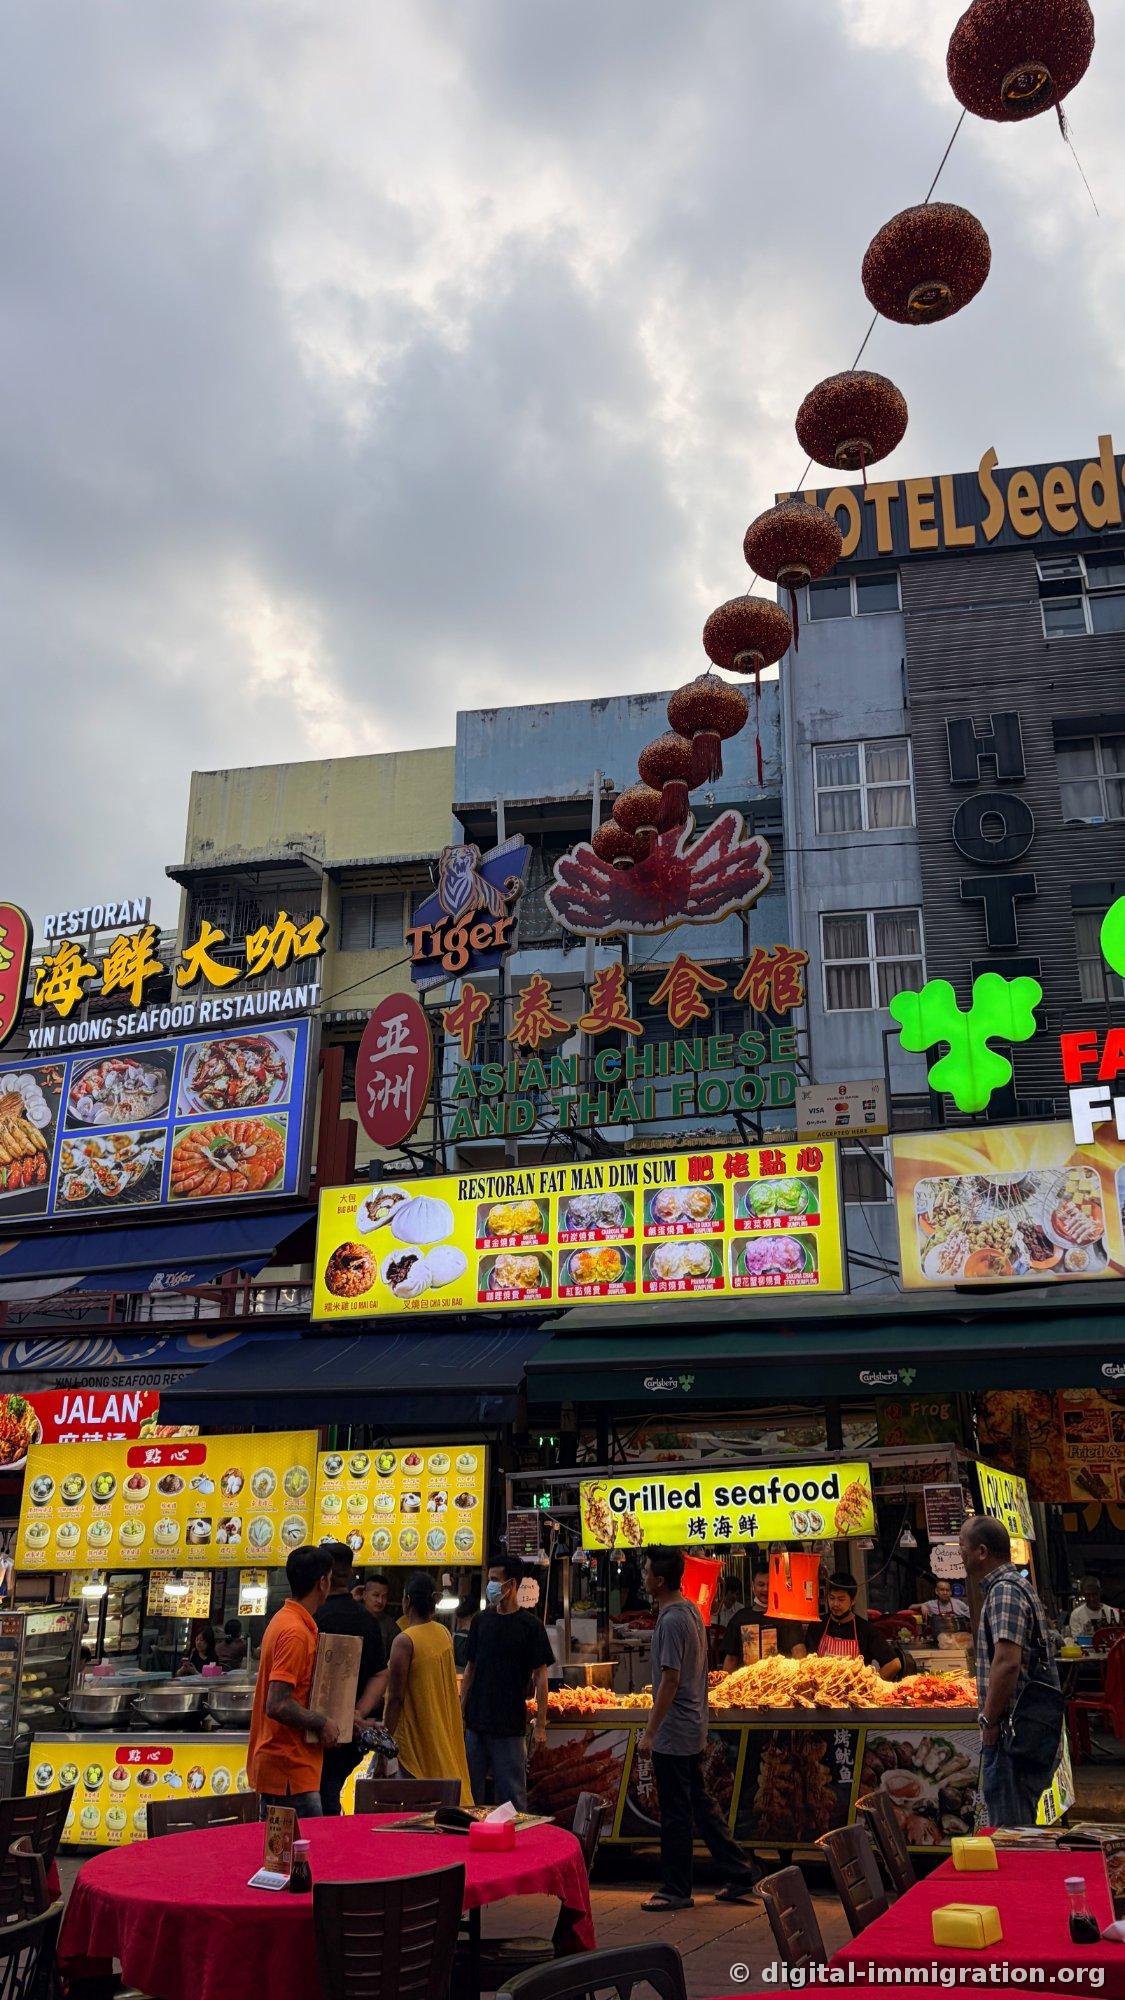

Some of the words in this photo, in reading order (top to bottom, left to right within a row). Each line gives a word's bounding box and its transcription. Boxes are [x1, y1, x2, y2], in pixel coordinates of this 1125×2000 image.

[779, 475, 976, 558] OTEL
[977, 434, 1125, 541] Seed
[44, 896, 149, 937] RESTORAN
[406, 911, 514, 972] Tiger
[28, 1028, 55, 1049] XIN
[59, 1017, 112, 1045] LOONG
[117, 1004, 195, 1035] SEAFOOD
[200, 983, 320, 1023] RESTAURANT
[443, 945, 810, 1060] 中泰美食馆
[367, 1013, 419, 1121] 亚洲
[450, 1053, 580, 1098] ASIAN
[594, 1026, 798, 1082] CHINESE
[448, 1101, 537, 1140] AND
[553, 1086, 656, 1128] THAI
[672, 1071, 801, 1117] FOOD
[809, 1107, 825, 1115] VISA
[458, 1173, 535, 1201] RESTORAN
[540, 1169, 567, 1194] FAT
[571, 1168, 604, 1191] MAN
[609, 1163, 638, 1188] DIM
[643, 1160, 676, 1184] SUM
[688, 1146, 824, 1183] 肥佬點心
[339, 1194, 356, 1205] 大包
[165, 1271, 196, 1288] Tiger
[112, 1374, 160, 1387] SEAFOOD
[644, 1376, 679, 1392] Carlsberg
[859, 1370, 898, 1386] Carlsberg
[1101, 1363, 1125, 1379] Carls
[54, 1392, 140, 1425] JALAN
[910, 1403, 950, 1420] Frog
[144, 1448, 190, 1465] 點心
[1069, 1445, 1104, 1458] Fried
[609, 1482, 702, 1513] Grilled
[714, 1474, 840, 1508] seafood
[688, 1514, 760, 1540] 烤海鲜
[127, 1749, 162, 1763] 點心
[834, 1729, 854, 1785] 烤鱿鱼
